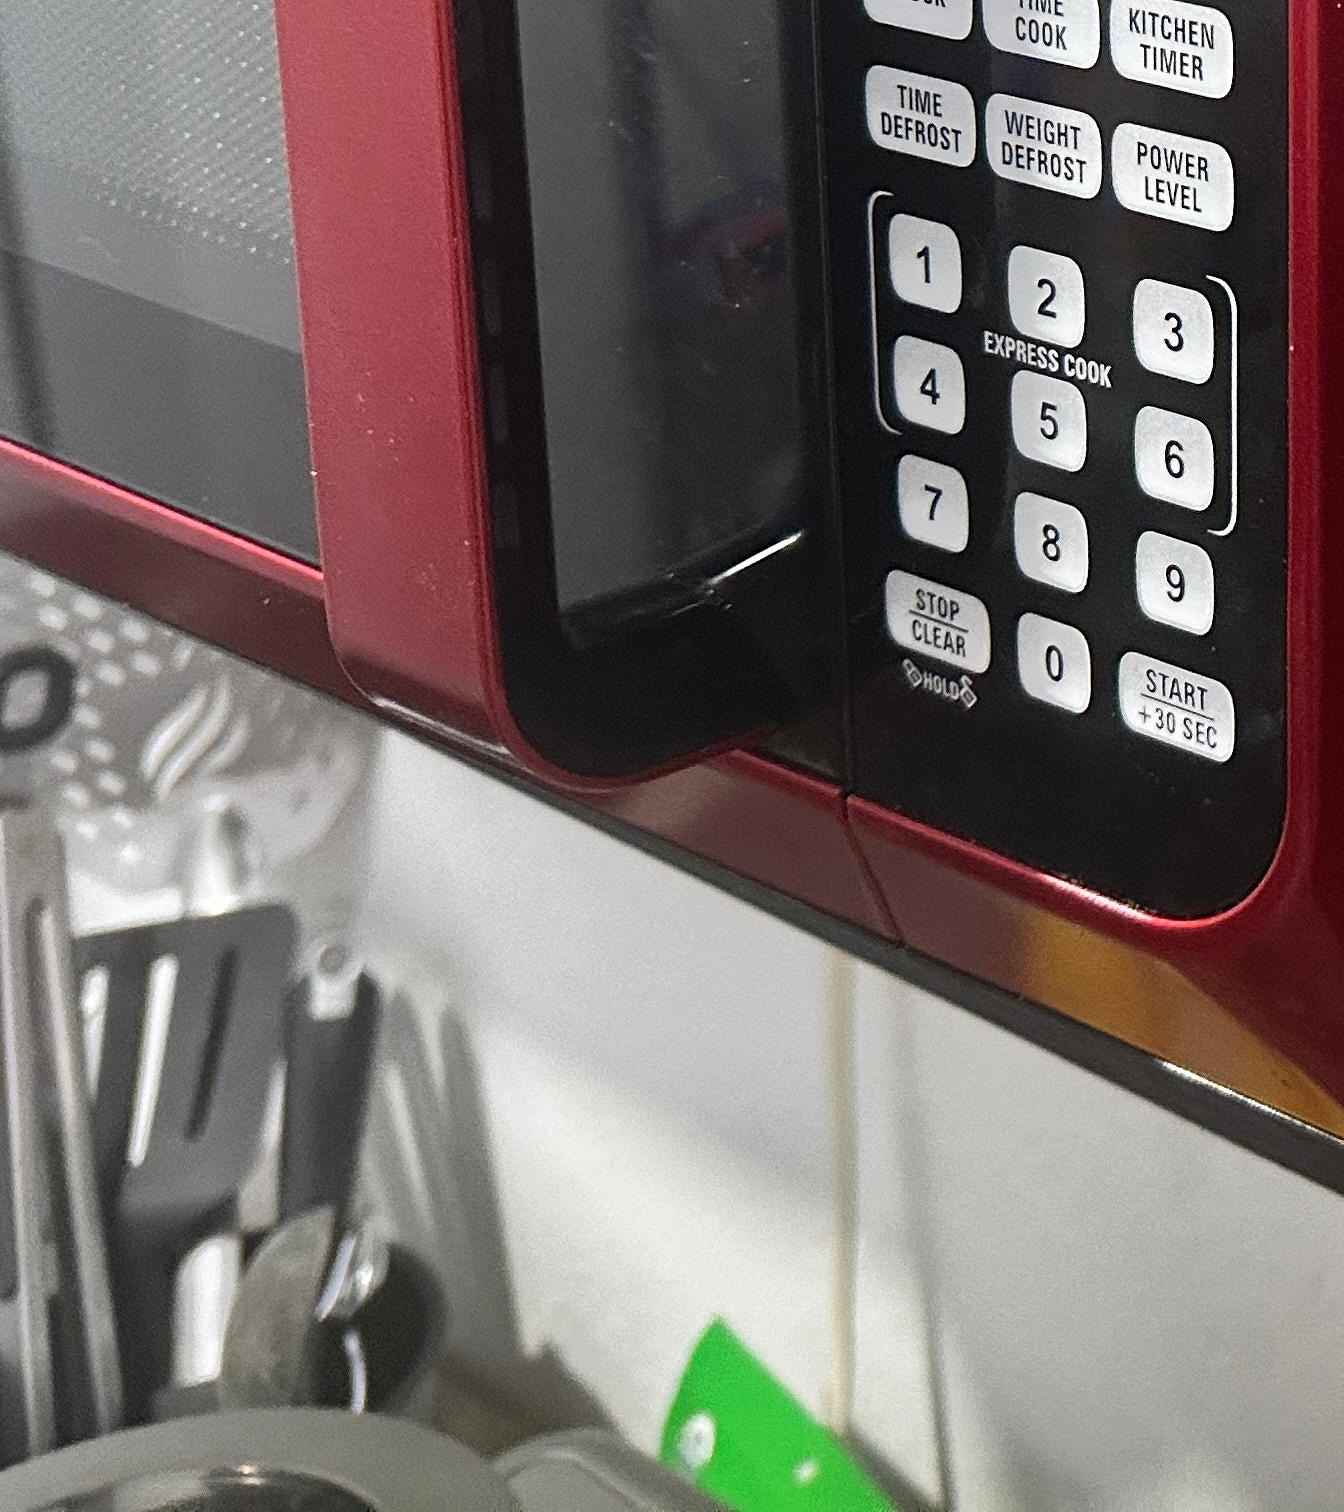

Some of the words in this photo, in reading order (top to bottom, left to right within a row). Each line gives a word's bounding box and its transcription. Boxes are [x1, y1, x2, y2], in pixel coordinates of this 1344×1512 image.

[1015, 16, 1068, 51] COOK
[1129, 7, 1215, 50] KITCHEN
[1140, 43, 1204, 81] TIMER
[897, 83, 943, 118] TIME
[880, 112, 962, 153] DEFROST
[1005, 110, 1081, 149] WEIGHT
[1002, 141, 1087, 184] DEFROST
[1137, 141, 1209, 182] POWER
[1144, 175, 1202, 213] LEVEL
[916, 246, 932, 284] 1
[1037, 278, 1058, 318] 2
[1163, 312, 1185, 353] 3
[984, 330, 1059, 373] EXPRESS
[1064, 352, 1112, 388] COOK
[920, 367, 940, 405] 4
[1039, 401, 1058, 440] 5
[1164, 440, 1185, 479] 6
[924, 484, 943, 521] 7
[1042, 523, 1061, 562] 8
[1165, 564, 1185, 603] 9
[916, 588, 961, 622] STOP
[912, 619, 967, 658] CLEAR
[1045, 644, 1064, 683] 0
[923, 673, 959, 699] HOLD
[1146, 668, 1208, 711] START
[1182, 718, 1218, 750] SEC
